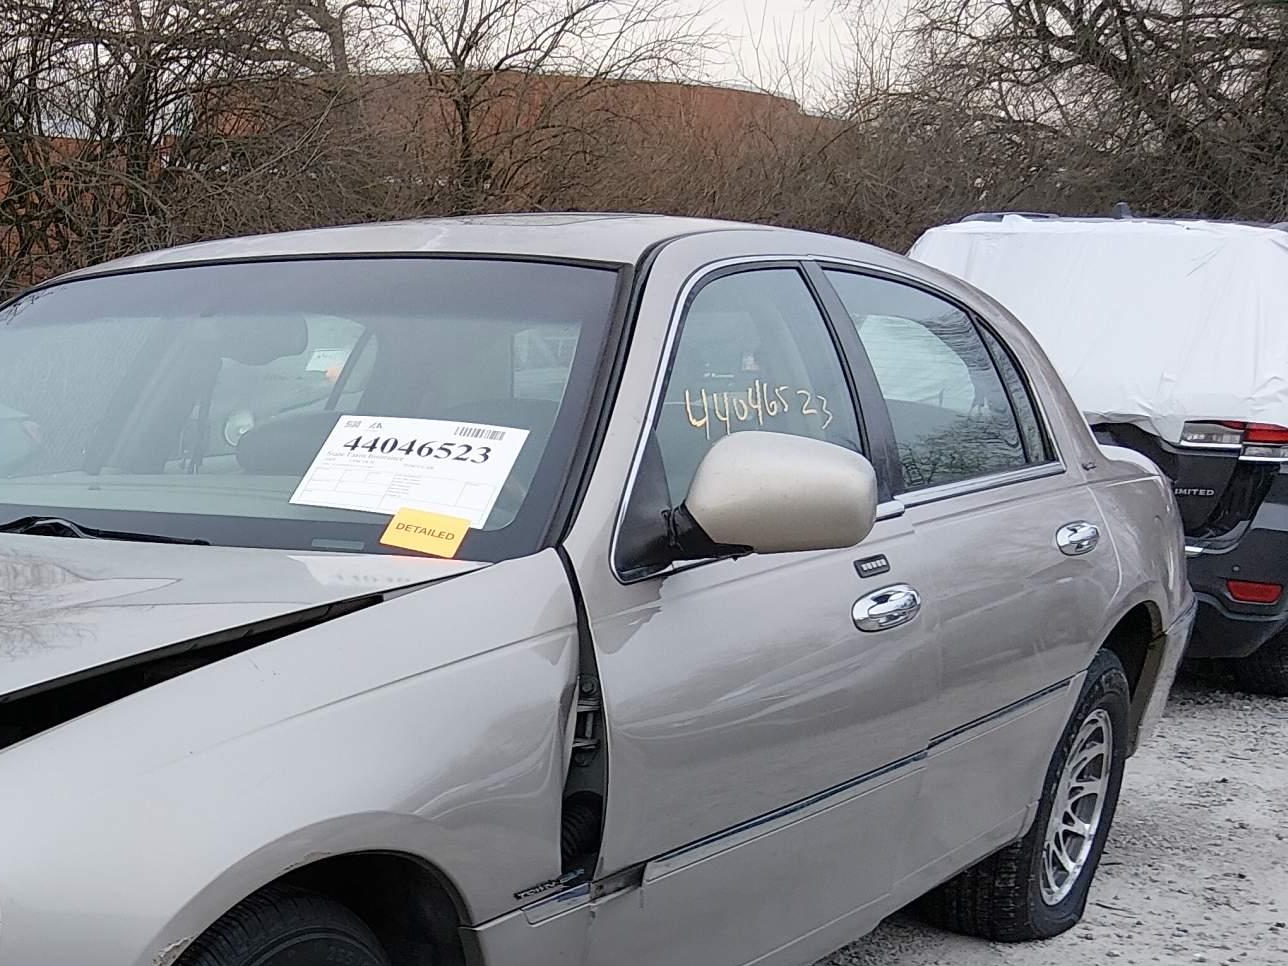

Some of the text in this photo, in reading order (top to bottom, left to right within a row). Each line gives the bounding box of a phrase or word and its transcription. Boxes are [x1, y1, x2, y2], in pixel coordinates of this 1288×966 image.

[684, 379, 834, 440] 44046523
[343, 435, 492, 464] 44046523
[1174, 488, 1215, 496] IMITED
[394, 522, 456, 541] DETAILED
